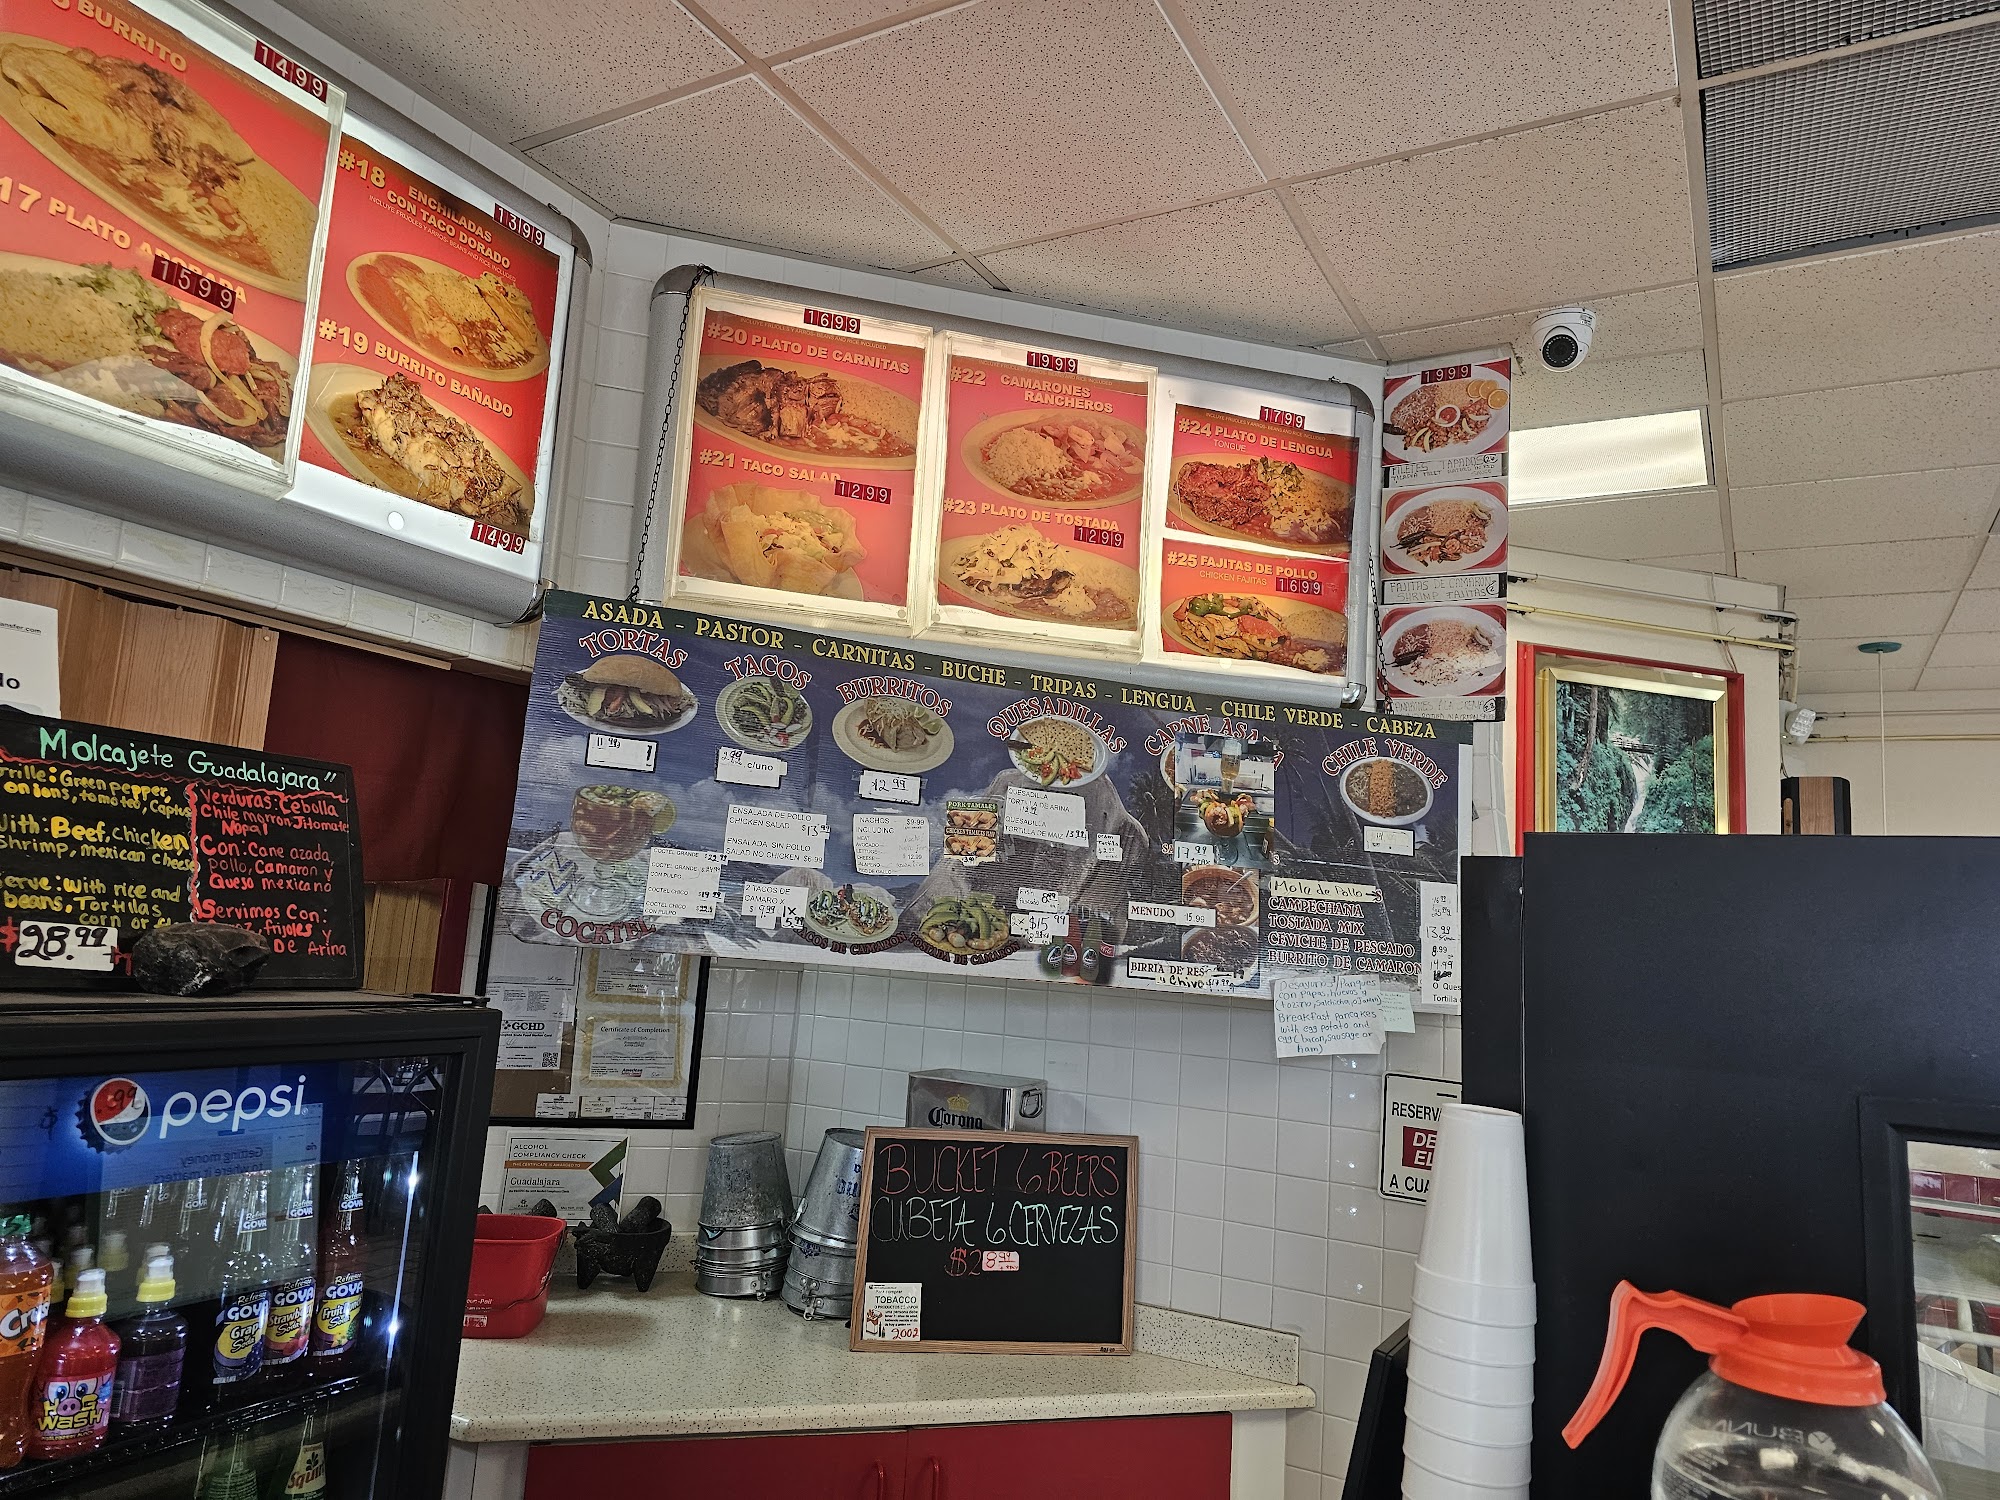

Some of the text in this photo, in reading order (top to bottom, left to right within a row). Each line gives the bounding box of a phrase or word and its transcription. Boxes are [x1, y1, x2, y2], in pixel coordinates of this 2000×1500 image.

[78, 0, 188, 72] BURRITO
[261, 45, 325, 98] 1499
[338, 149, 386, 188] #18
[48, 197, 131, 250] PLATO
[408, 185, 492, 243] ENCHILADAS
[387, 189, 510, 269] CON TACO DORADO
[498, 207, 543, 246] 1399
[160, 260, 233, 309] 1599
[808, 311, 859, 333] 1699
[707, 322, 748, 345] #20
[751, 334, 803, 354] PLATO
[807, 344, 828, 359] DE
[832, 349, 910, 374] CARNITAS
[318, 319, 514, 418] #19 BURRITO BAÑADO
[1030, 352, 1076, 373] 1999
[950, 366, 987, 386] #22
[1424, 365, 1469, 383] 1999
[1000, 374, 1092, 399] CAMARONES
[1024, 391, 1113, 413] RANCHEROS
[1263, 407, 1304, 428] 1799
[1178, 417, 1212, 437] #24
[1215, 425, 1257, 444] PLATO
[1260, 434, 1277, 448] DE
[1280, 439, 1333, 458] LENGUA
[1213, 439, 1247, 452] TONGUE
[700, 449, 784, 477] #21 TACO
[839, 482, 888, 503] 1299
[943, 498, 1119, 532] #23 PLATO DE TOSTADA
[477, 524, 525, 553] 1499
[1078, 527, 1123, 547] 1299
[1167, 551, 1318, 580] #25 FAJITAS DE POLLO
[1200, 570, 1267, 586] CHICKEN FAJITAS
[1278, 577, 1321, 594] 1699
[1434, 578, 1446, 590] DE
[578, 628, 688, 669] TORTAS
[582, 600, 1437, 739] ASADA PASTOR CARNITAS BUCHE TRIPAS LENGUA CHILE VERDE CABEZA
[724, 654, 812, 690] TACOS
[836, 675, 952, 718] BURRITOS
[986, 696, 1127, 755] QUESADILLAS
[39, 727, 174, 772] Molcajete
[1321, 737, 1449, 790] CHILE VERDE
[1008, 787, 1049, 800] QUESADILLA
[200, 804, 240, 821] Chile
[729, 816, 764, 826] CHICKEN
[733, 806, 812, 821] ENSALADA DE POLLO
[222, 820, 269, 837] Nopal
[1004, 825, 1047, 837] TORTILLA DE
[81, 843, 146, 863] mexican
[726, 848, 750, 856] SALAD
[766, 852, 800, 861] CHICKEN
[727, 838, 768, 848] ENSALADA
[786, 843, 811, 852] POLLO
[254, 859, 318, 877] Camaron
[114, 882, 181, 903] rice and
[209, 873, 332, 893] Queso mexicano
[753, 885, 778, 893] TACOS
[199, 899, 281, 920] Servimos
[1130, 904, 1175, 919] MENUDO
[1268, 896, 1365, 918] CAMPECHANA
[79, 912, 149, 930] corn or
[263, 919, 313, 938] frijoles
[540, 908, 656, 945] COCKTEL
[1268, 913, 1365, 936] TOSTADA MIX
[307, 940, 347, 957] Arina
[830, 932, 907, 955] DE CAMARON
[909, 932, 969, 965] TOSTADA DE
[1268, 932, 1416, 957] CEVICHE DE PESCADO
[1131, 961, 1205, 977] BIRRIA DE RES
[1268, 950, 1422, 976] BURRITO DE CAMARON
[512, 1022, 546, 1031] GCHD
[600, 1025, 670, 1034] Certificate of Completion
[1303, 1025, 1318, 1034] egg
[159, 1075, 307, 1139] pepsi
[928, 1106, 984, 1129] Corona
[879, 1143, 1006, 1195] BUCKET
[1015, 1147, 1043, 1195] 6
[1041, 1150, 1120, 1198] BEERS
[1389, 1173, 1399, 1189] A
[510, 1176, 561, 1188] Guadalajara
[289, 1205, 313, 1217] GOYA
[340, 1199, 364, 1209] GOYA
[243, 1218, 267, 1230] GOYA
[871, 1195, 1119, 1247] CUBETA 6 CERVEZAS
[273, 1286, 314, 1306] GOYA
[326, 1280, 364, 1299] GOYA
[875, 1295, 917, 1304] TOBACCO
[227, 1300, 269, 1321] GOYA
[276, 1320, 302, 1337] Soda
[230, 1335, 257, 1355] Soda
